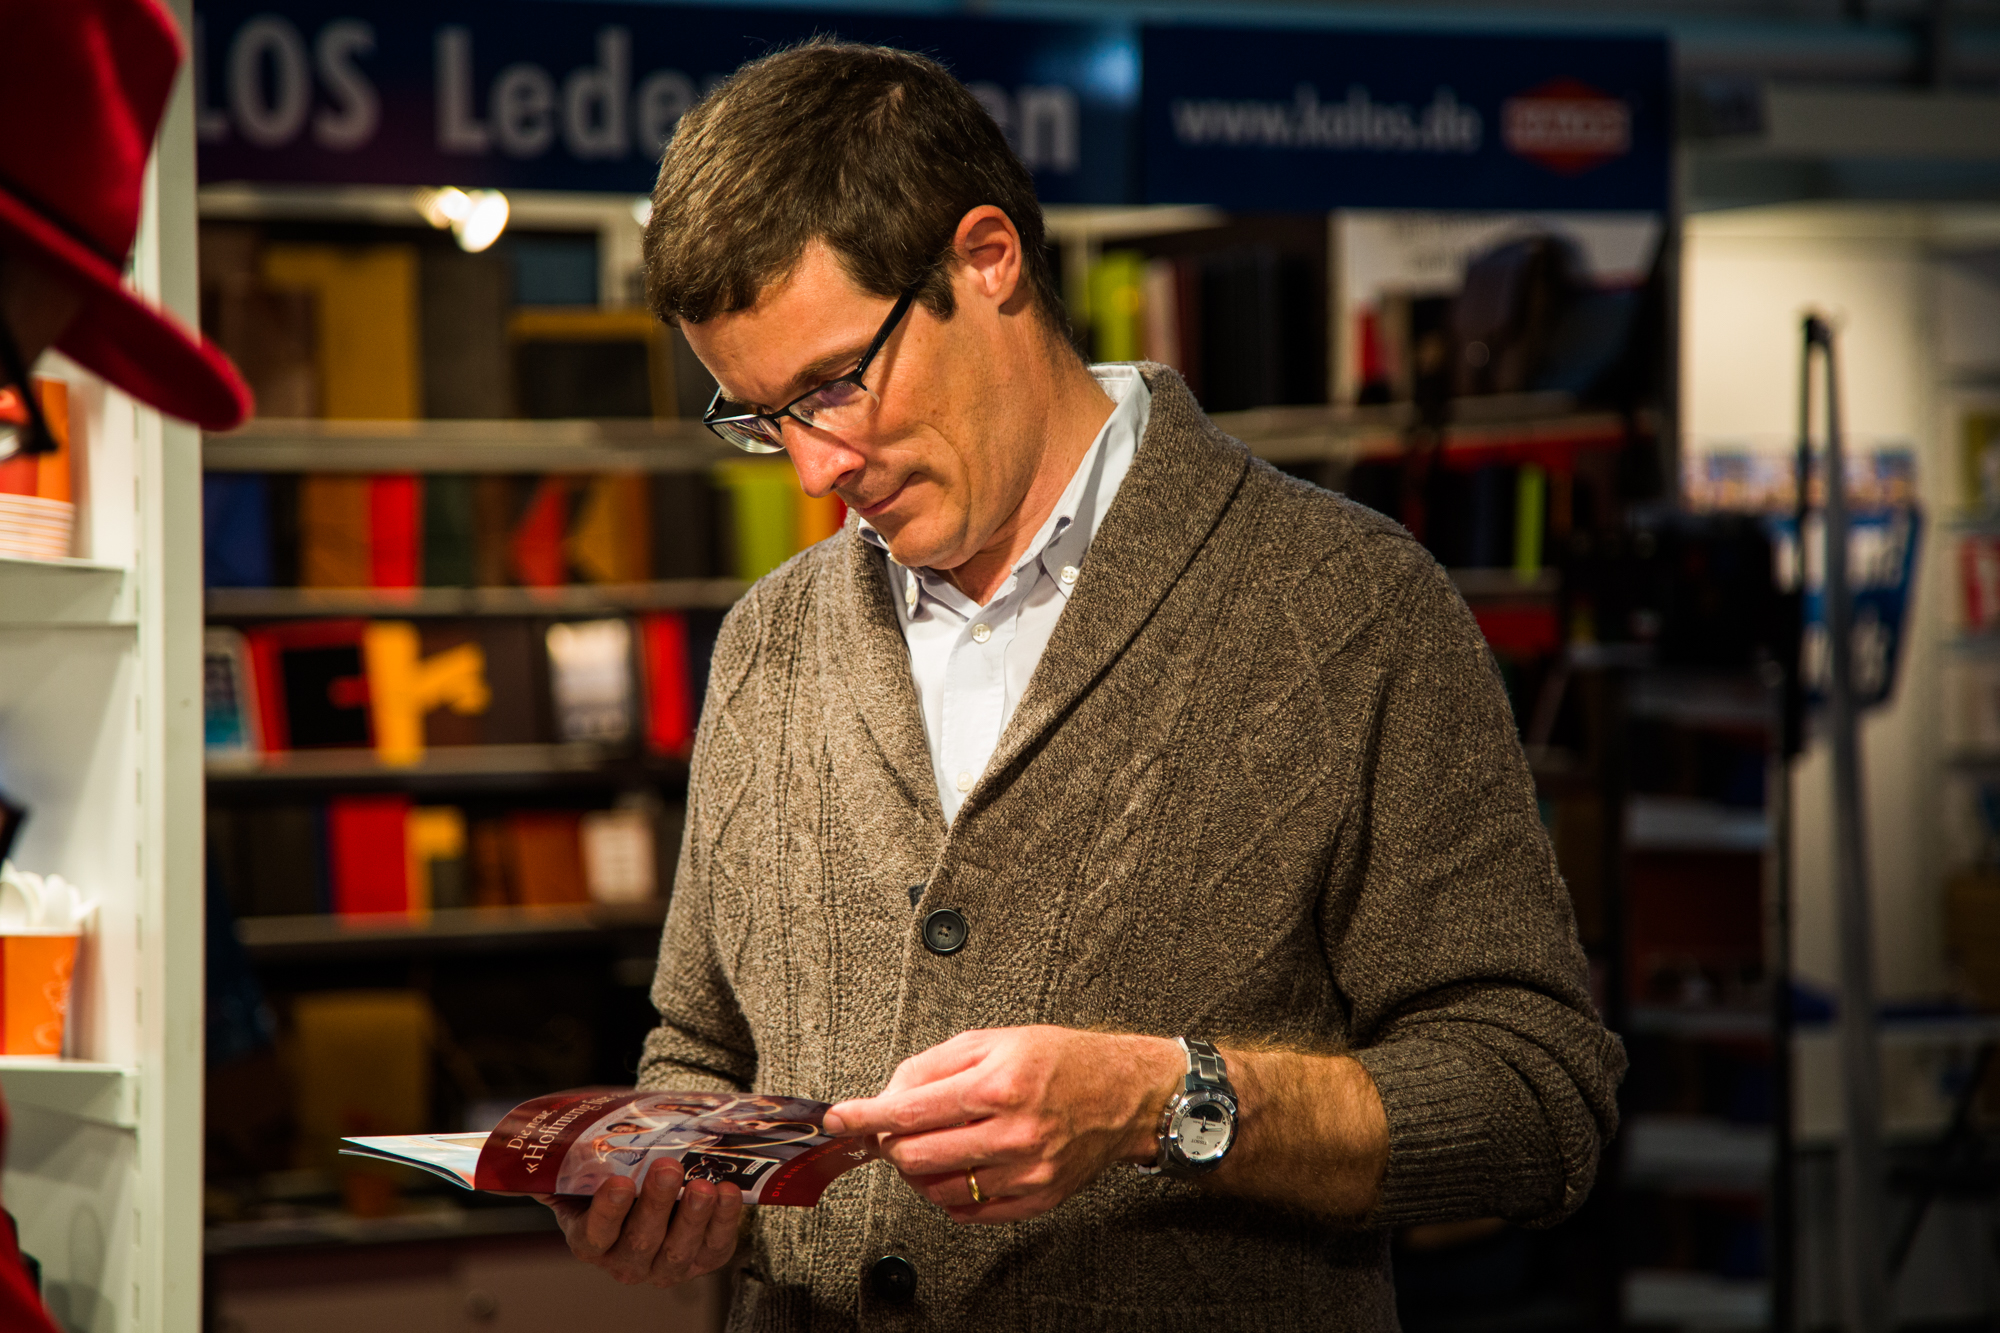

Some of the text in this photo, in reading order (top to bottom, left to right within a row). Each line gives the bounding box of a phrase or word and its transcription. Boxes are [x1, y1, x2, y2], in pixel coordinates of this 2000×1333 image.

[432, 23, 720, 162] Lede
[507, 1129, 531, 1150] Die
[772, 1181, 785, 1197] DIE
